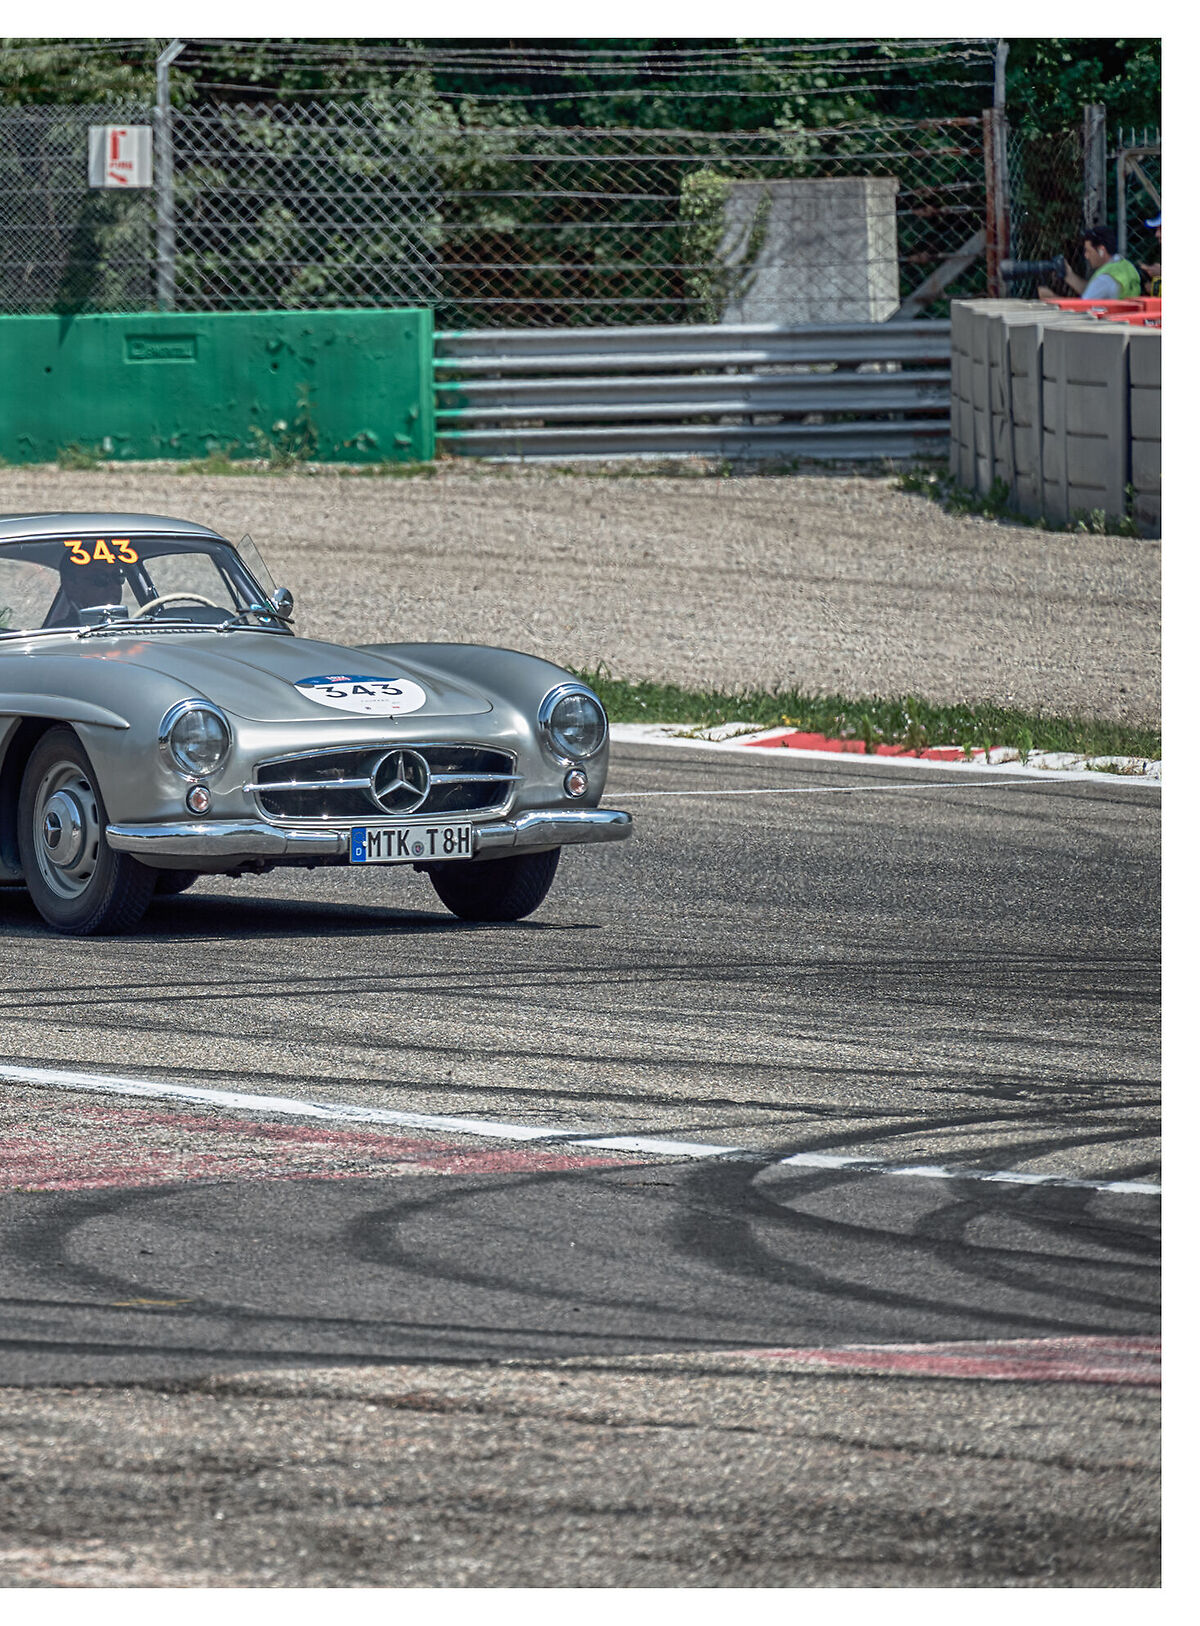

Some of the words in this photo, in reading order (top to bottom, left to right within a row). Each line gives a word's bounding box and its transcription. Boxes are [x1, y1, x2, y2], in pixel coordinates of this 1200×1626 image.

[63, 539, 139, 565] 343
[316, 684, 403, 698] 343
[355, 847, 362, 856] D
[367, 829, 410, 857] MTK
